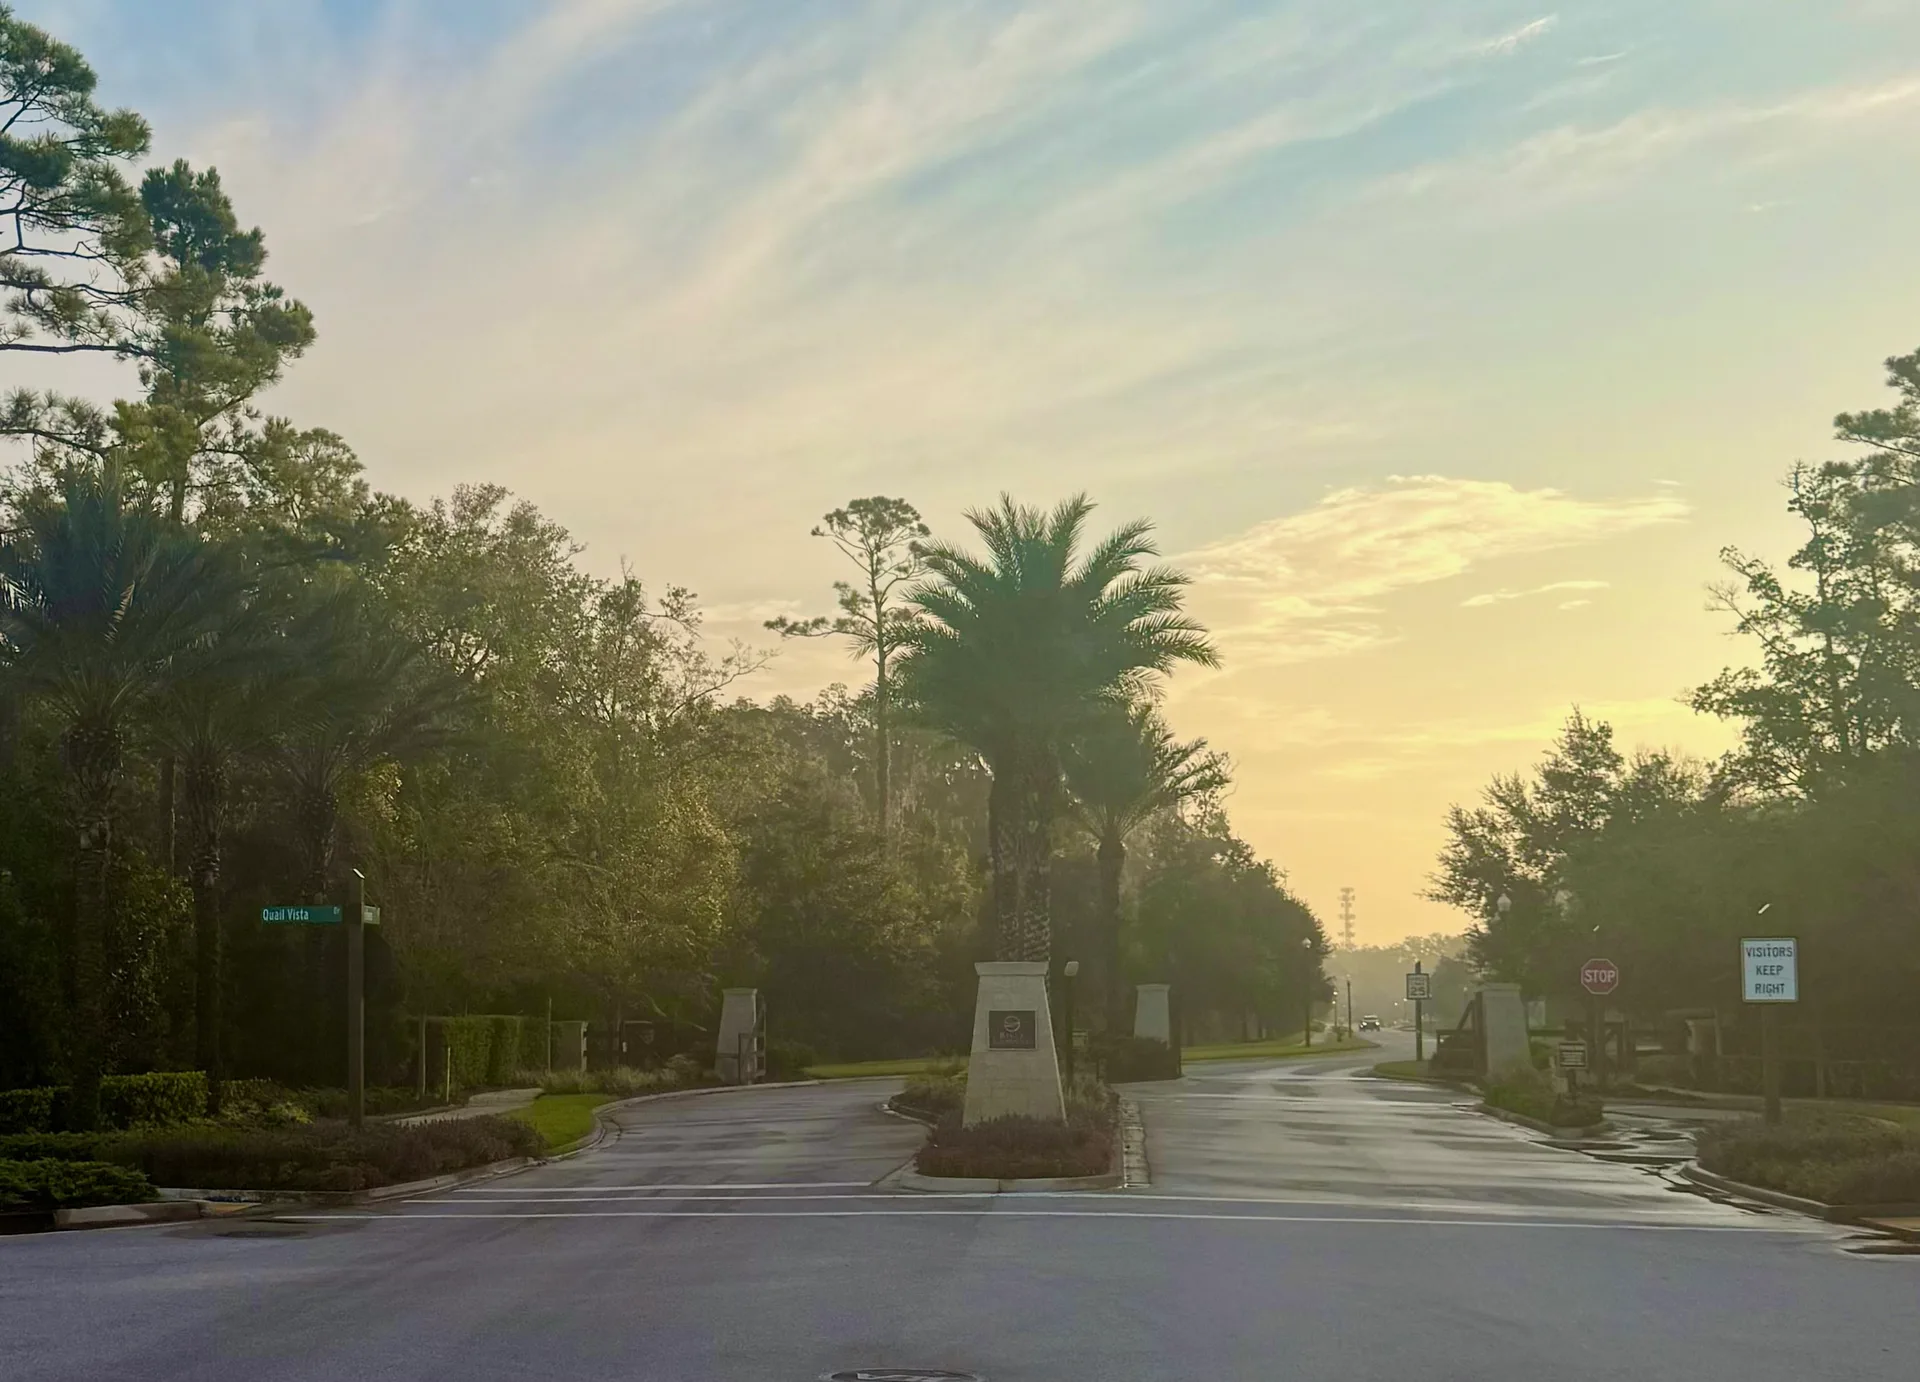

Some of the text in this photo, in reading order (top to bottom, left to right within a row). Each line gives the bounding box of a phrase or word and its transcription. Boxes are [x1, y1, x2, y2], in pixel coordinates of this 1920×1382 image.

[263, 908, 285, 921] Quail
[287, 908, 309, 921] Vista
[1746, 946, 1793, 957] VISITORS
[1756, 965, 1784, 975] KEEP
[1584, 969, 1615, 983] STOP
[1410, 986, 1425, 996] 25
[1755, 983, 1785, 994] RIGHT
